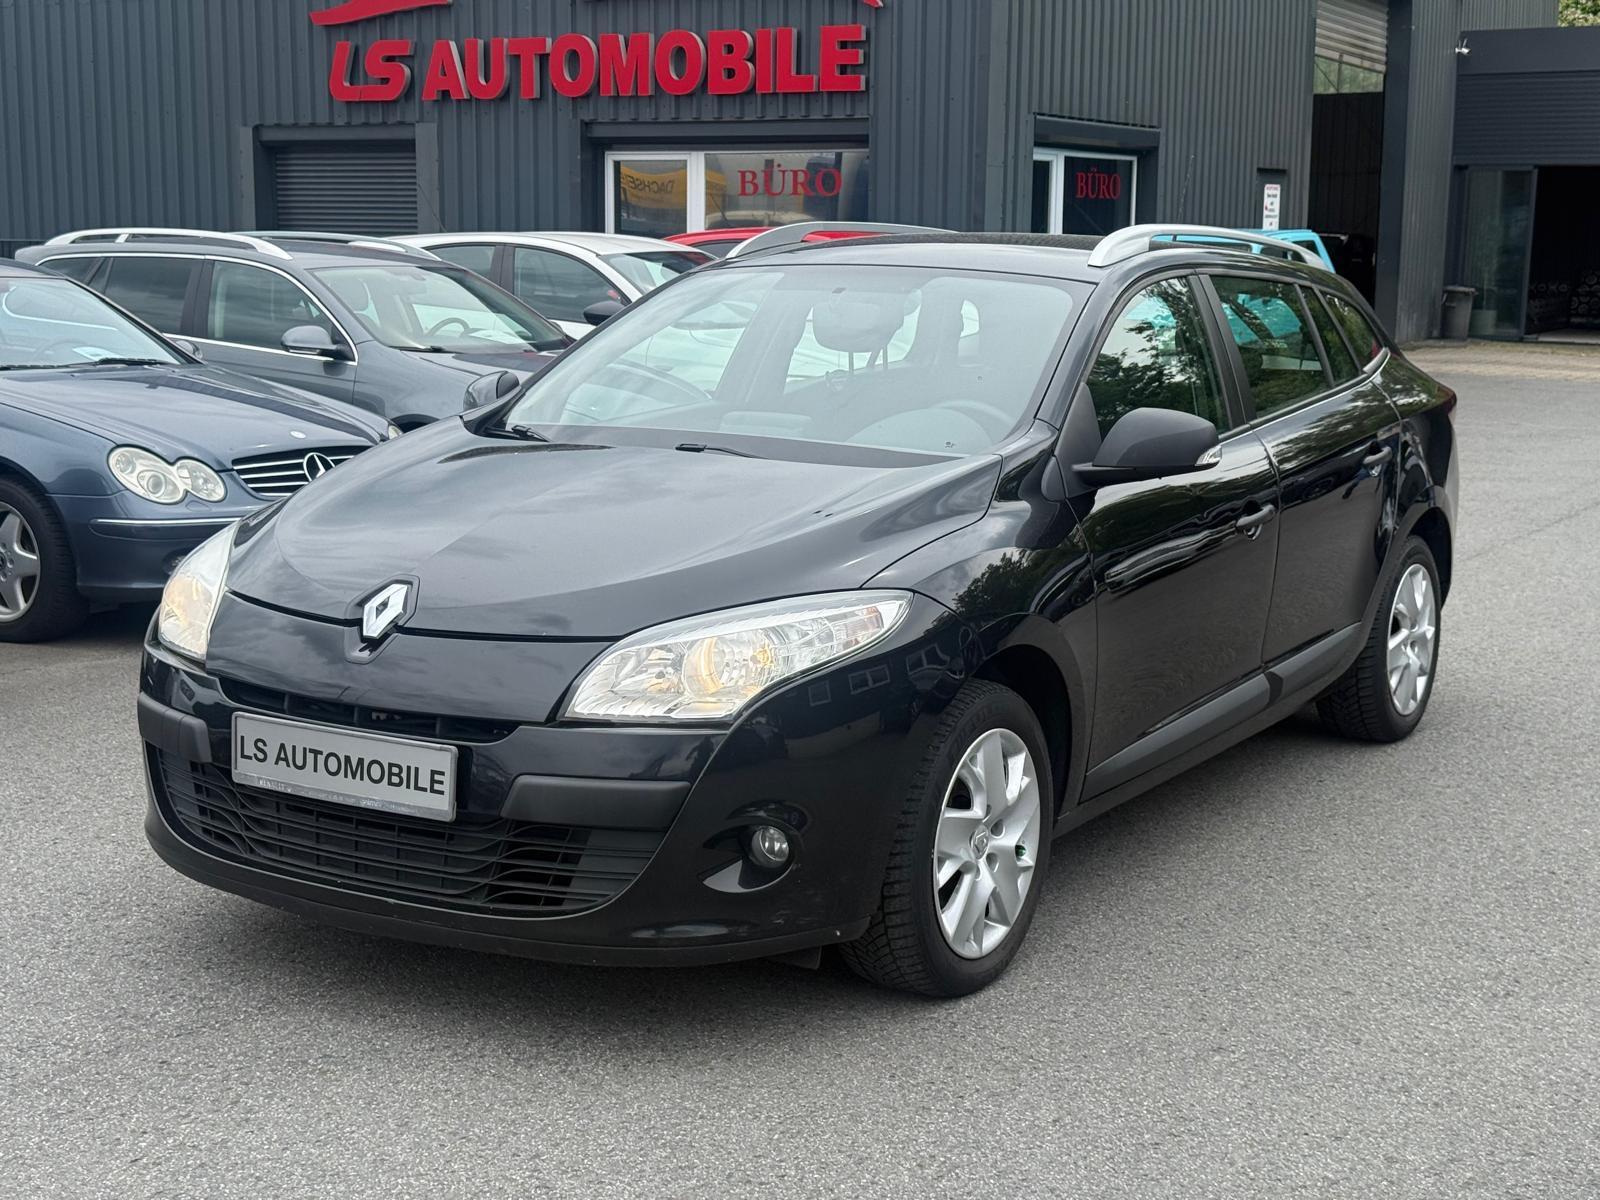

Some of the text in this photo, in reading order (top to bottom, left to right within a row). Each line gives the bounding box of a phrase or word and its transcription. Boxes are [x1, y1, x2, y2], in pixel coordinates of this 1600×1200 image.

[329, 24, 866, 102] LS AUTOMOBILE
[737, 163, 842, 196] BÜRO
[1076, 168, 1121, 199] BÜRO
[240, 735, 268, 763] LS
[274, 742, 446, 796] AUTOMOBILE
